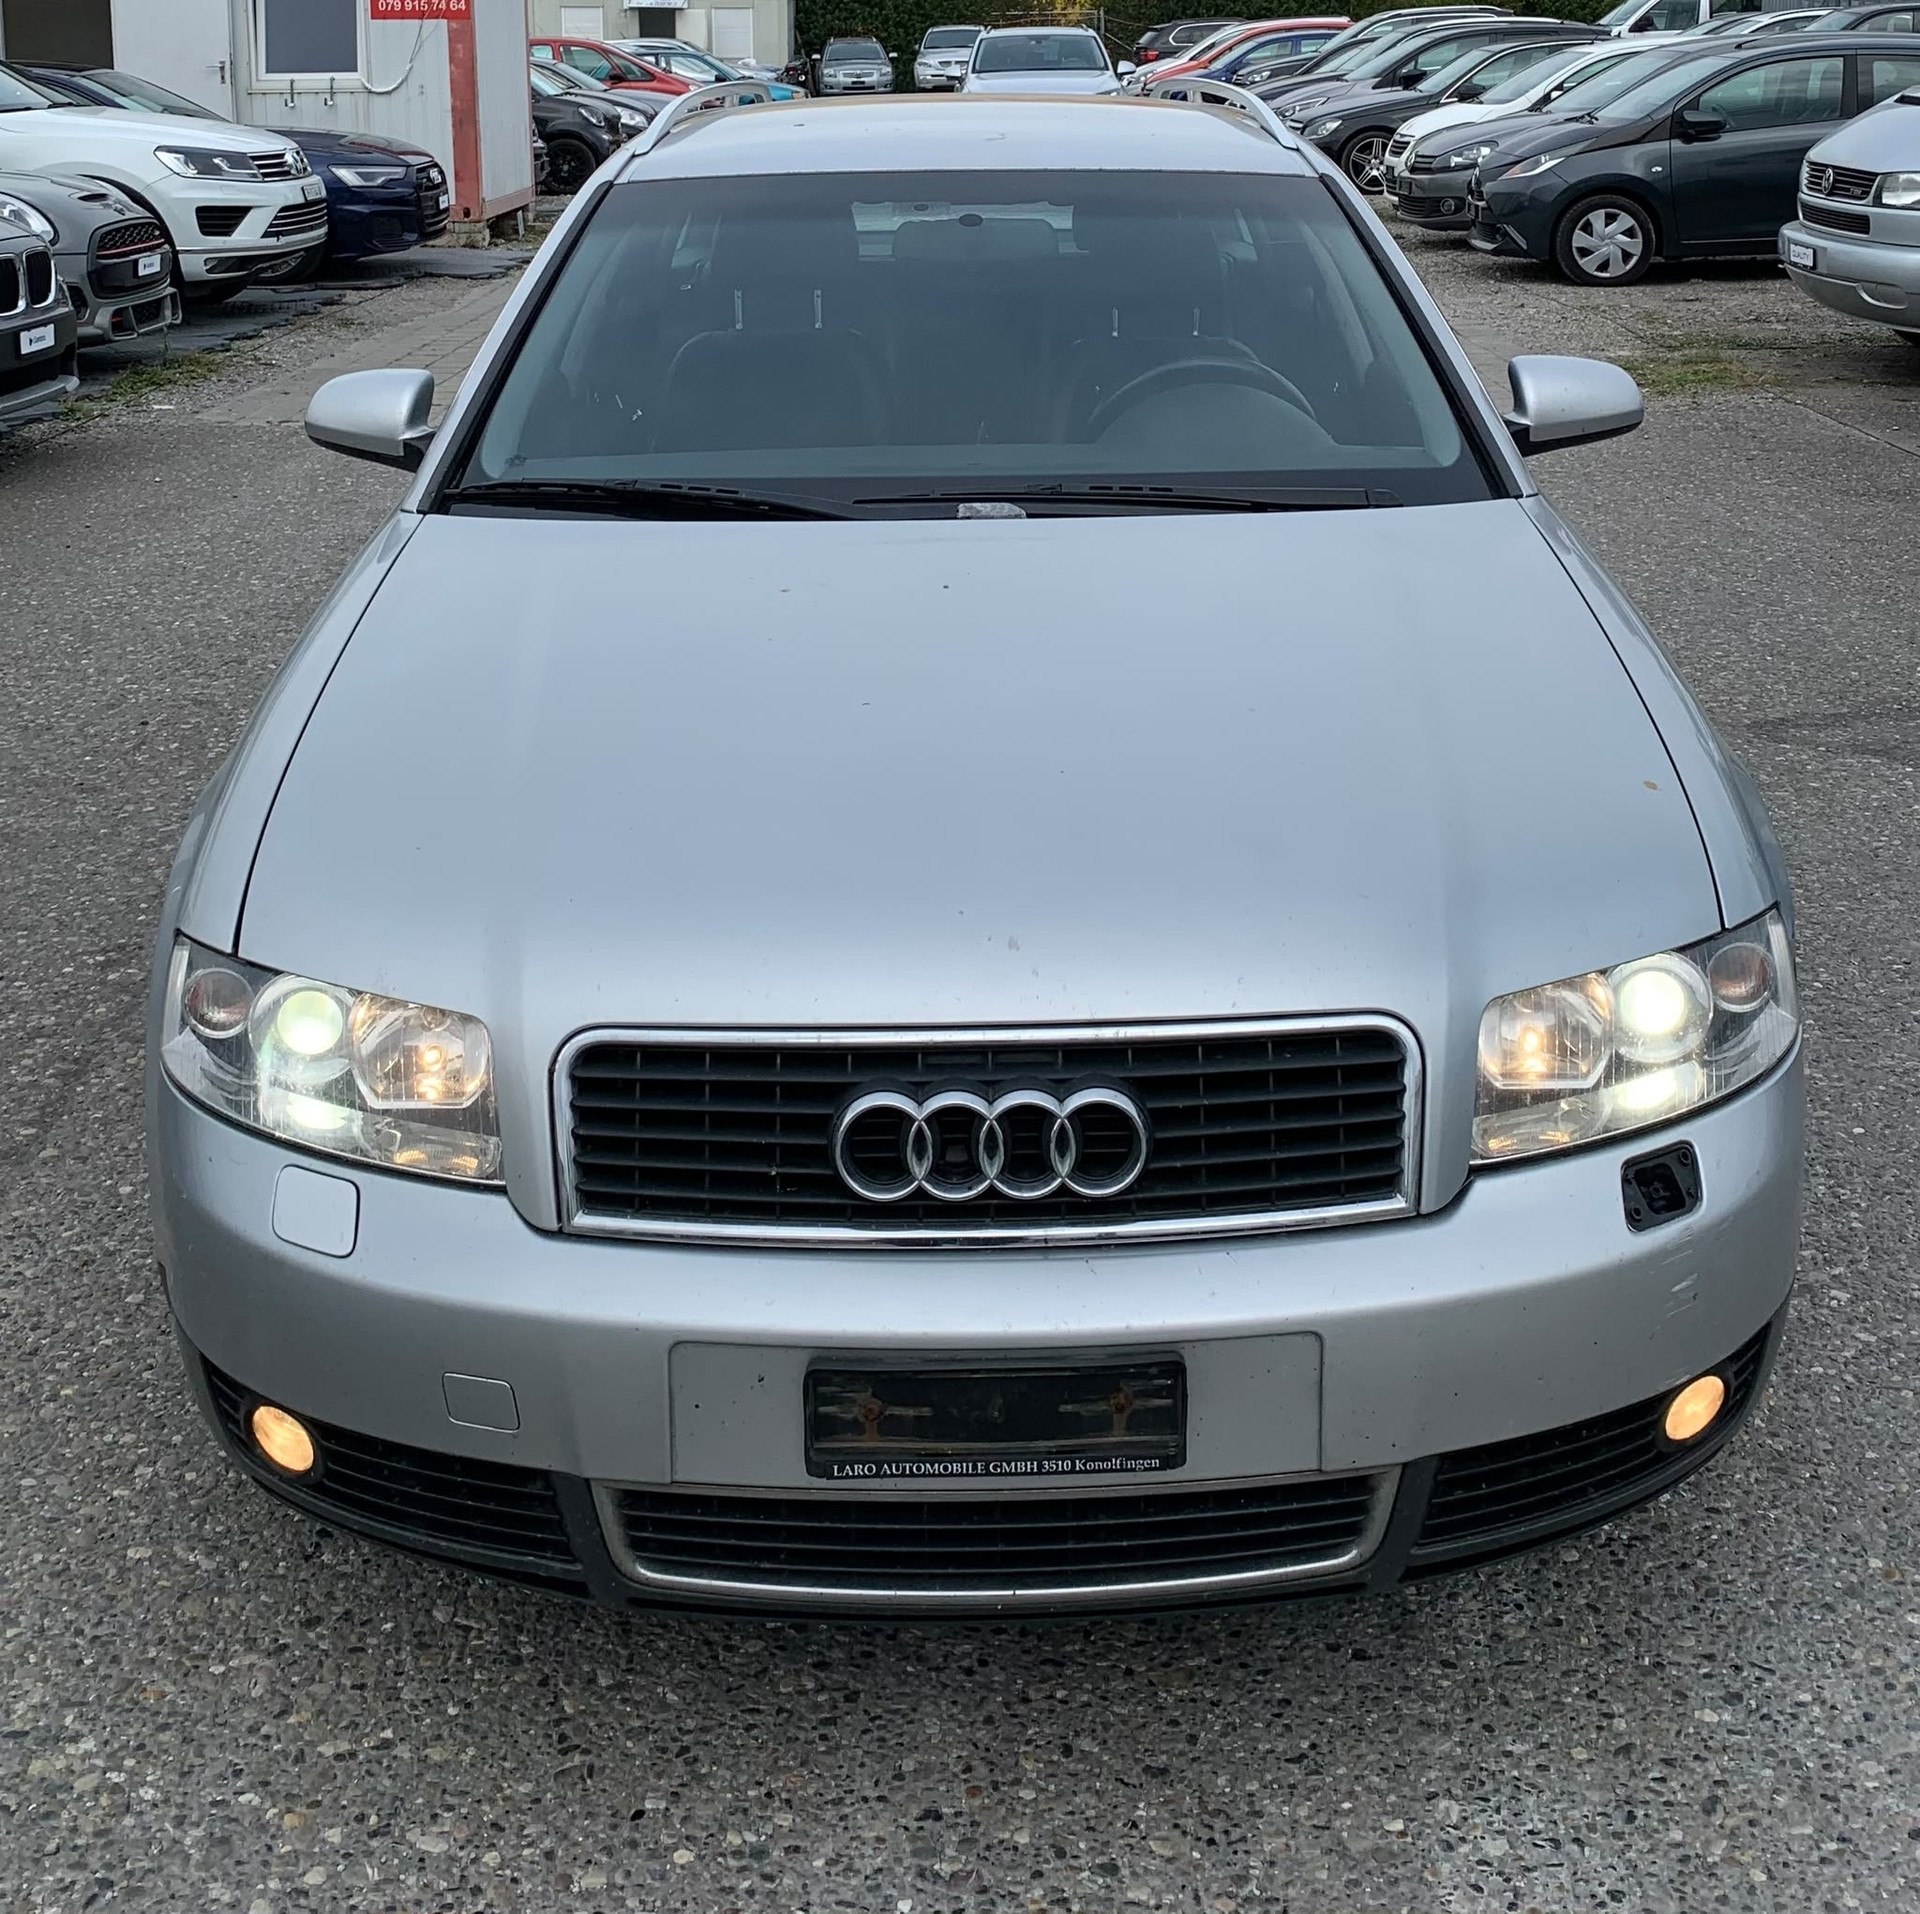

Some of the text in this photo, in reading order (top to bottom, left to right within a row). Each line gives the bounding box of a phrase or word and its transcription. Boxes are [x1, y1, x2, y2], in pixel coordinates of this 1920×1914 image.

[378, 0, 466, 11] 079 915 74 64
[833, 1457, 1160, 1477] LARO AUTOMOBILE GMBH 3510 Konolfingen
